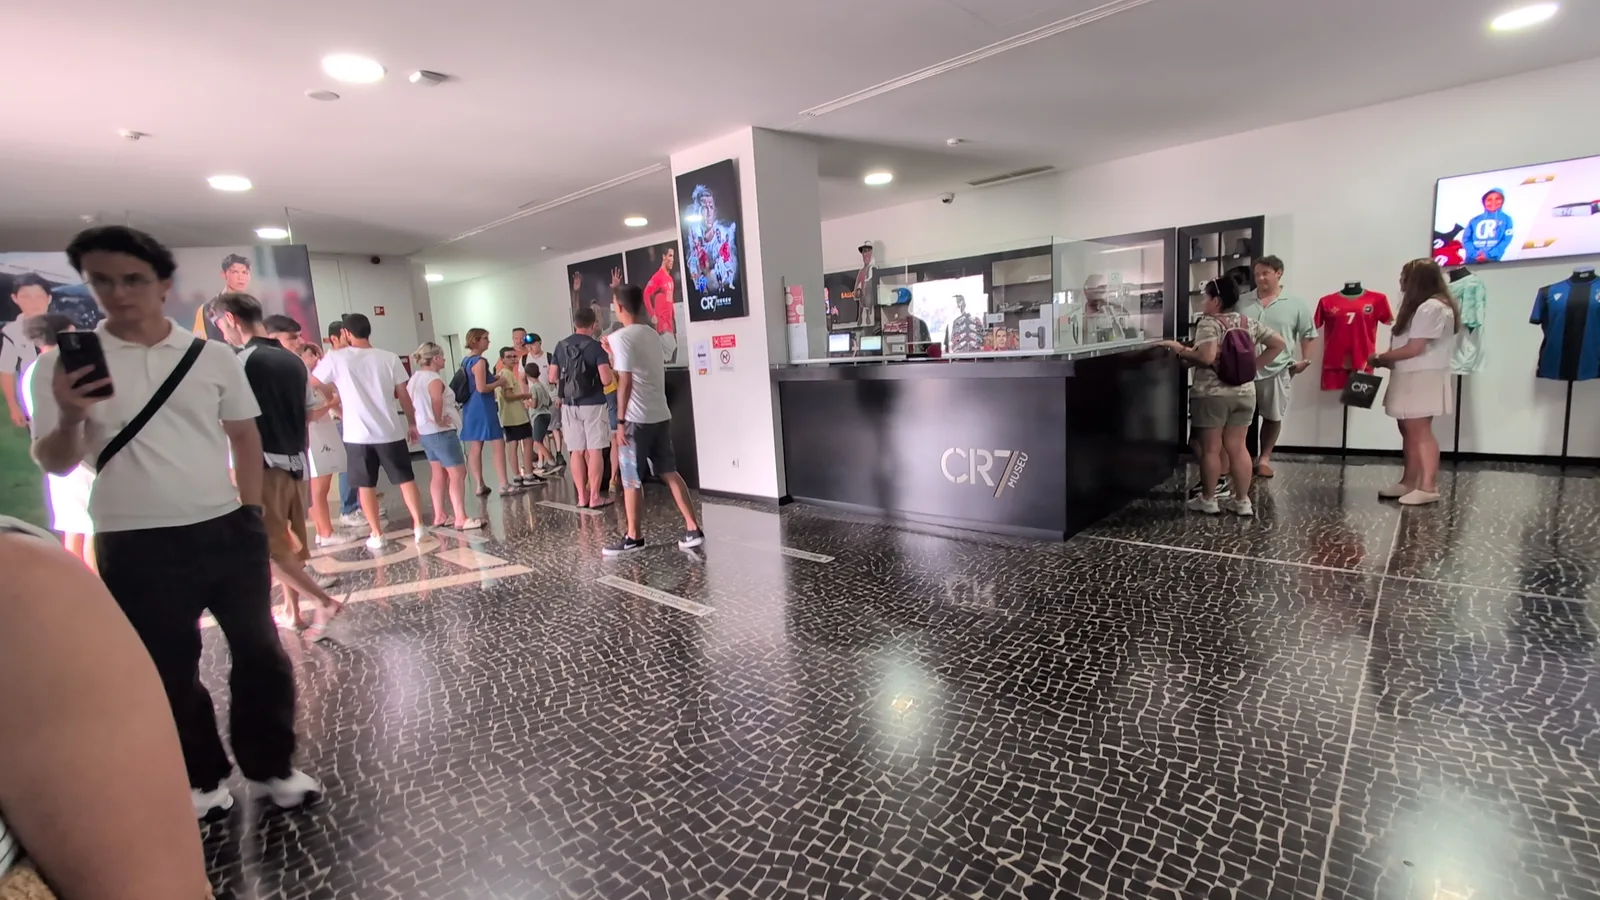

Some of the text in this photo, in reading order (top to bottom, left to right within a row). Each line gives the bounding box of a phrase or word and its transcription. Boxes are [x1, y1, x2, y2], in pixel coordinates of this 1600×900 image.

[700, 295, 718, 312] CR7
[1346, 312, 1356, 325] 7
[941, 447, 1029, 498] CR7 MUSEU
